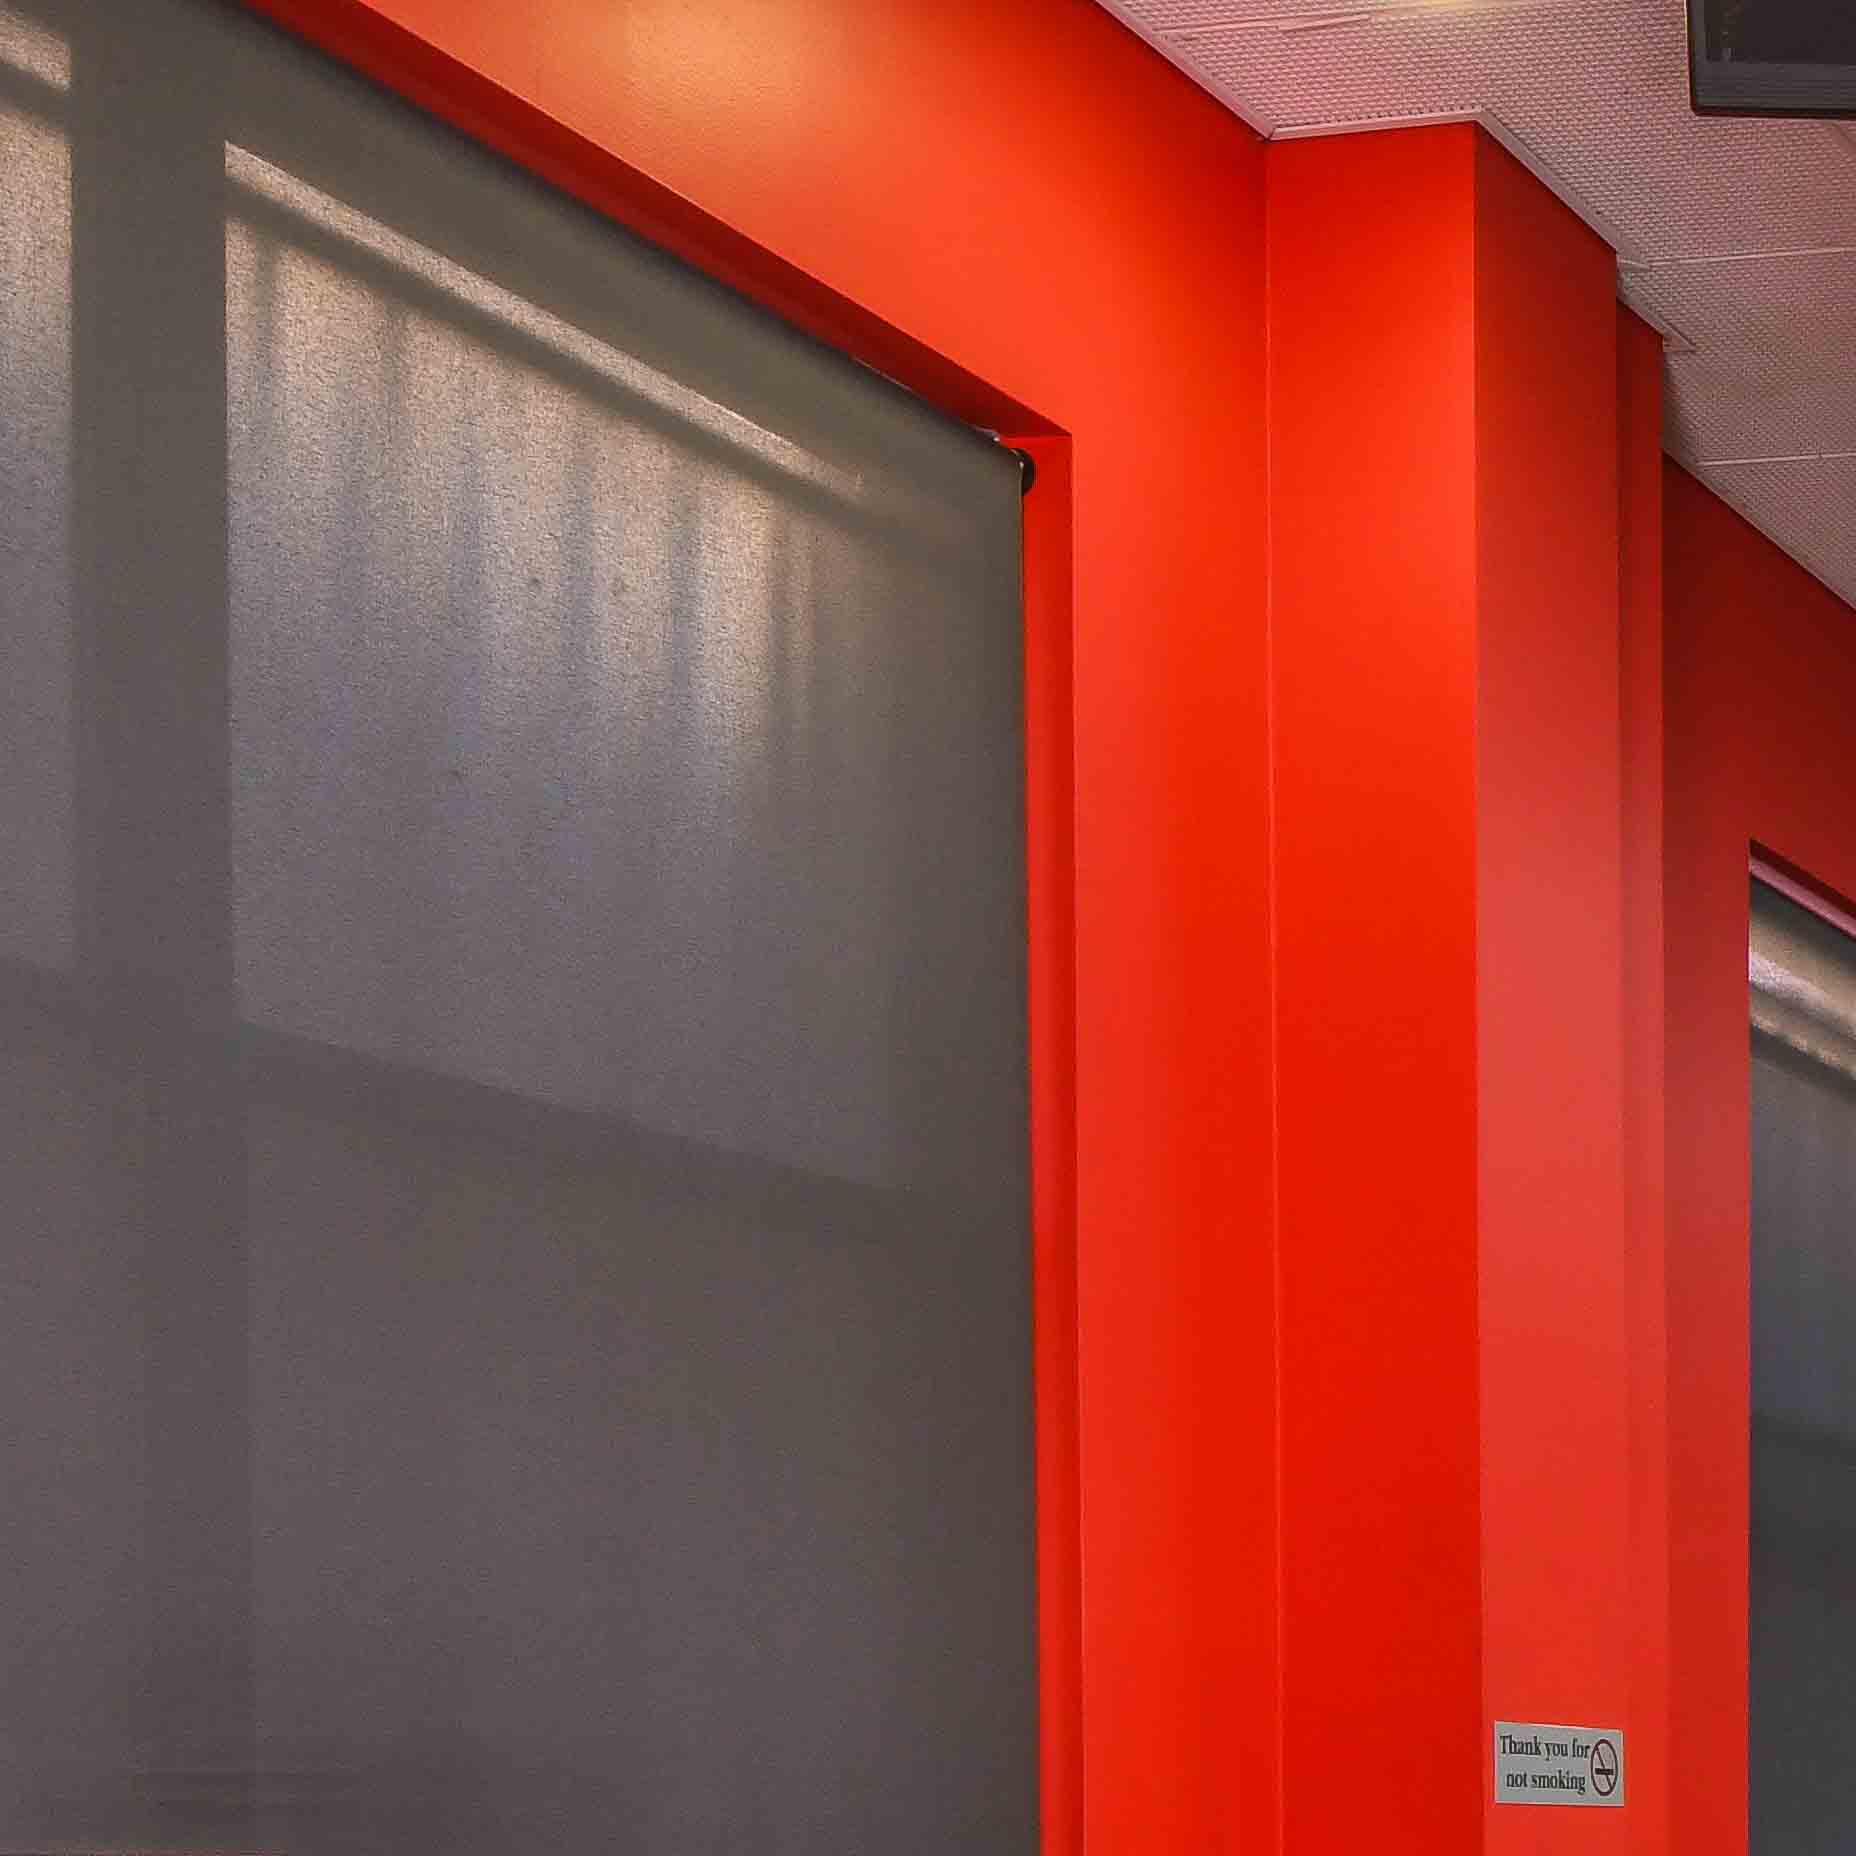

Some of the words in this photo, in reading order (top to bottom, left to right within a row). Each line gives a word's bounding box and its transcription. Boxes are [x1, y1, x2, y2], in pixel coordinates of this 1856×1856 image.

[1500, 1735, 1542, 1756] Thank
[1543, 1742, 1569, 1761] you
[1571, 1738, 1591, 1759] for
[1506, 1769, 1528, 1788] not
[1531, 1769, 1586, 1795] smoking
